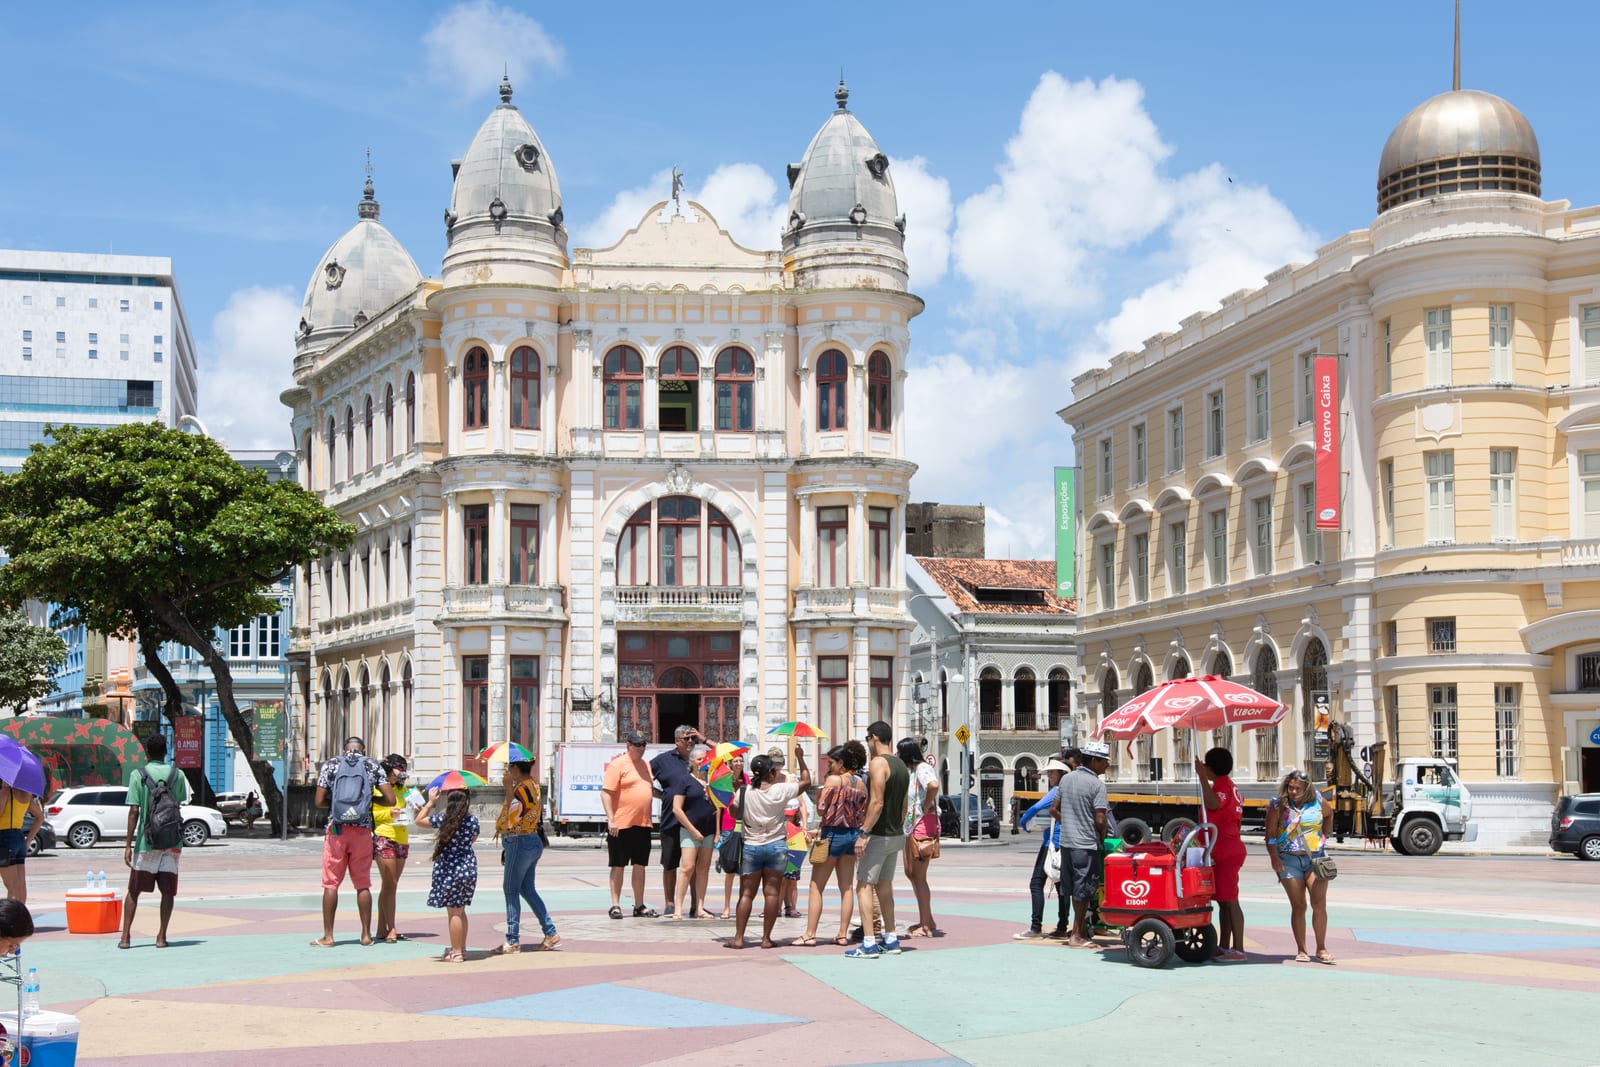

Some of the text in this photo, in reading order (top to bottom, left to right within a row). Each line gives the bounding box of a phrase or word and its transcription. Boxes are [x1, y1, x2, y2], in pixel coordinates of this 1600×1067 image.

[1320, 375, 1332, 452] Acervo Caixa
[1060, 481, 1069, 530] Exposições
[1233, 708, 1263, 717] KIBON
